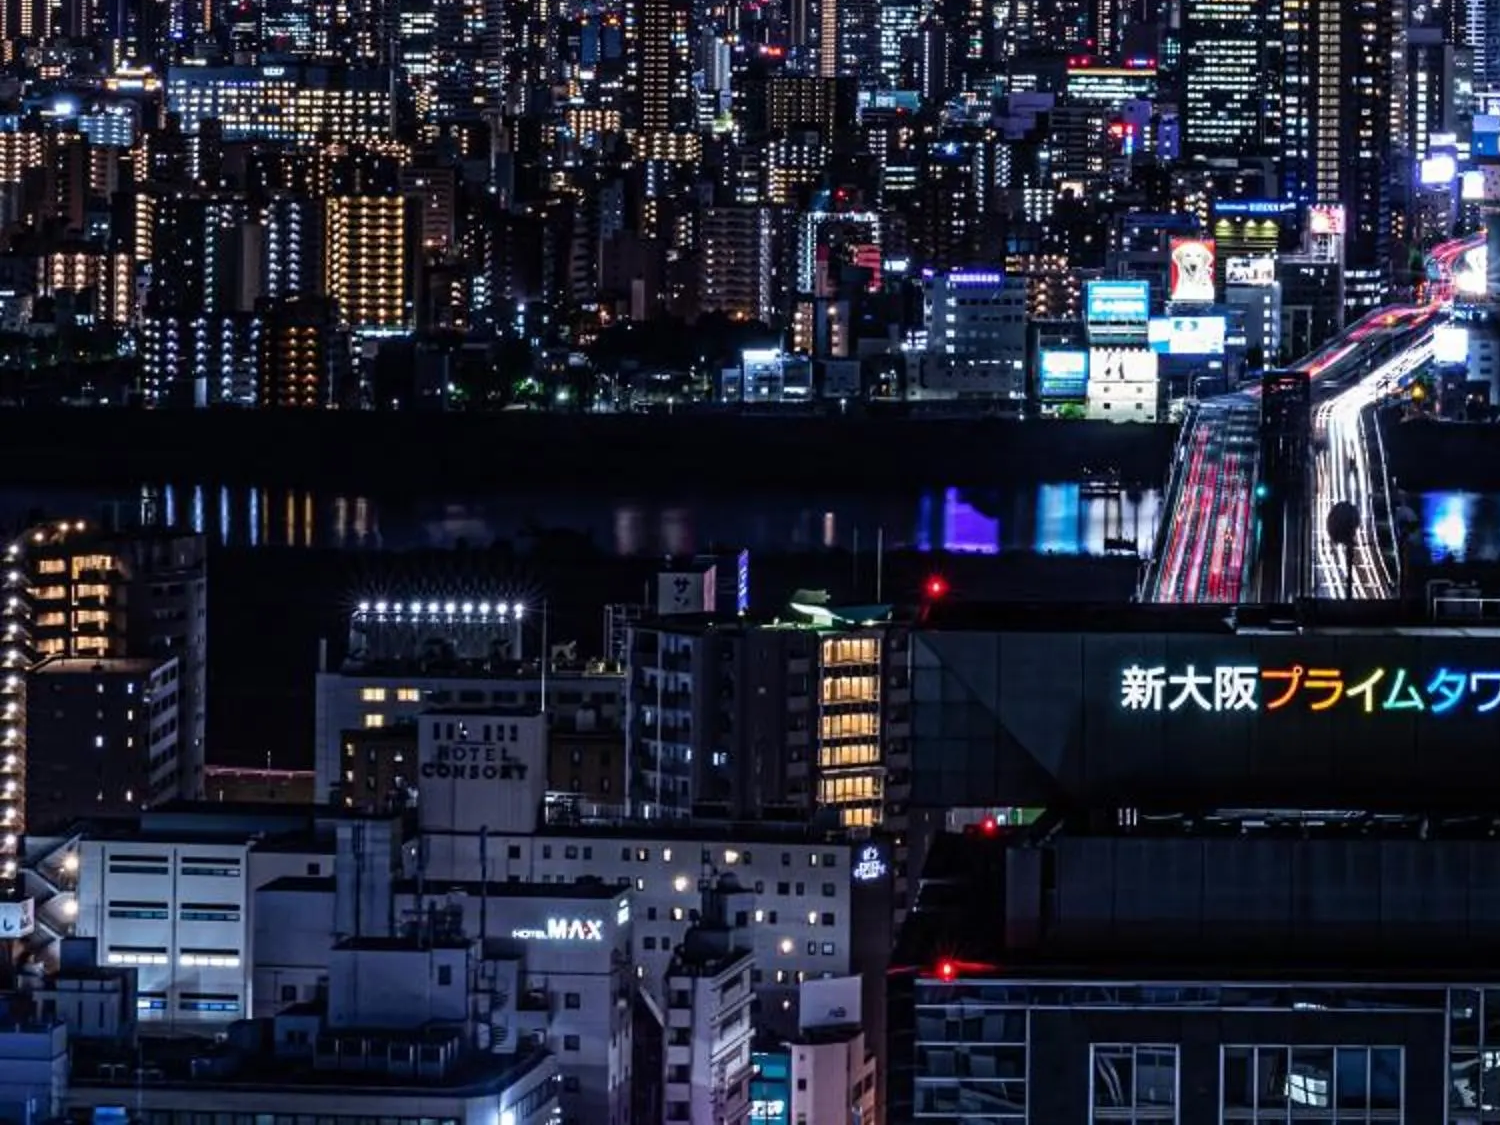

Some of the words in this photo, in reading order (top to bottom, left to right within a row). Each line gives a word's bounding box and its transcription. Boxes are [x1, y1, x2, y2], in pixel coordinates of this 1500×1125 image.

[437, 746, 510, 762] HOTEL
[511, 929, 547, 939] HOTEL
[547, 918, 603, 940] MAX
